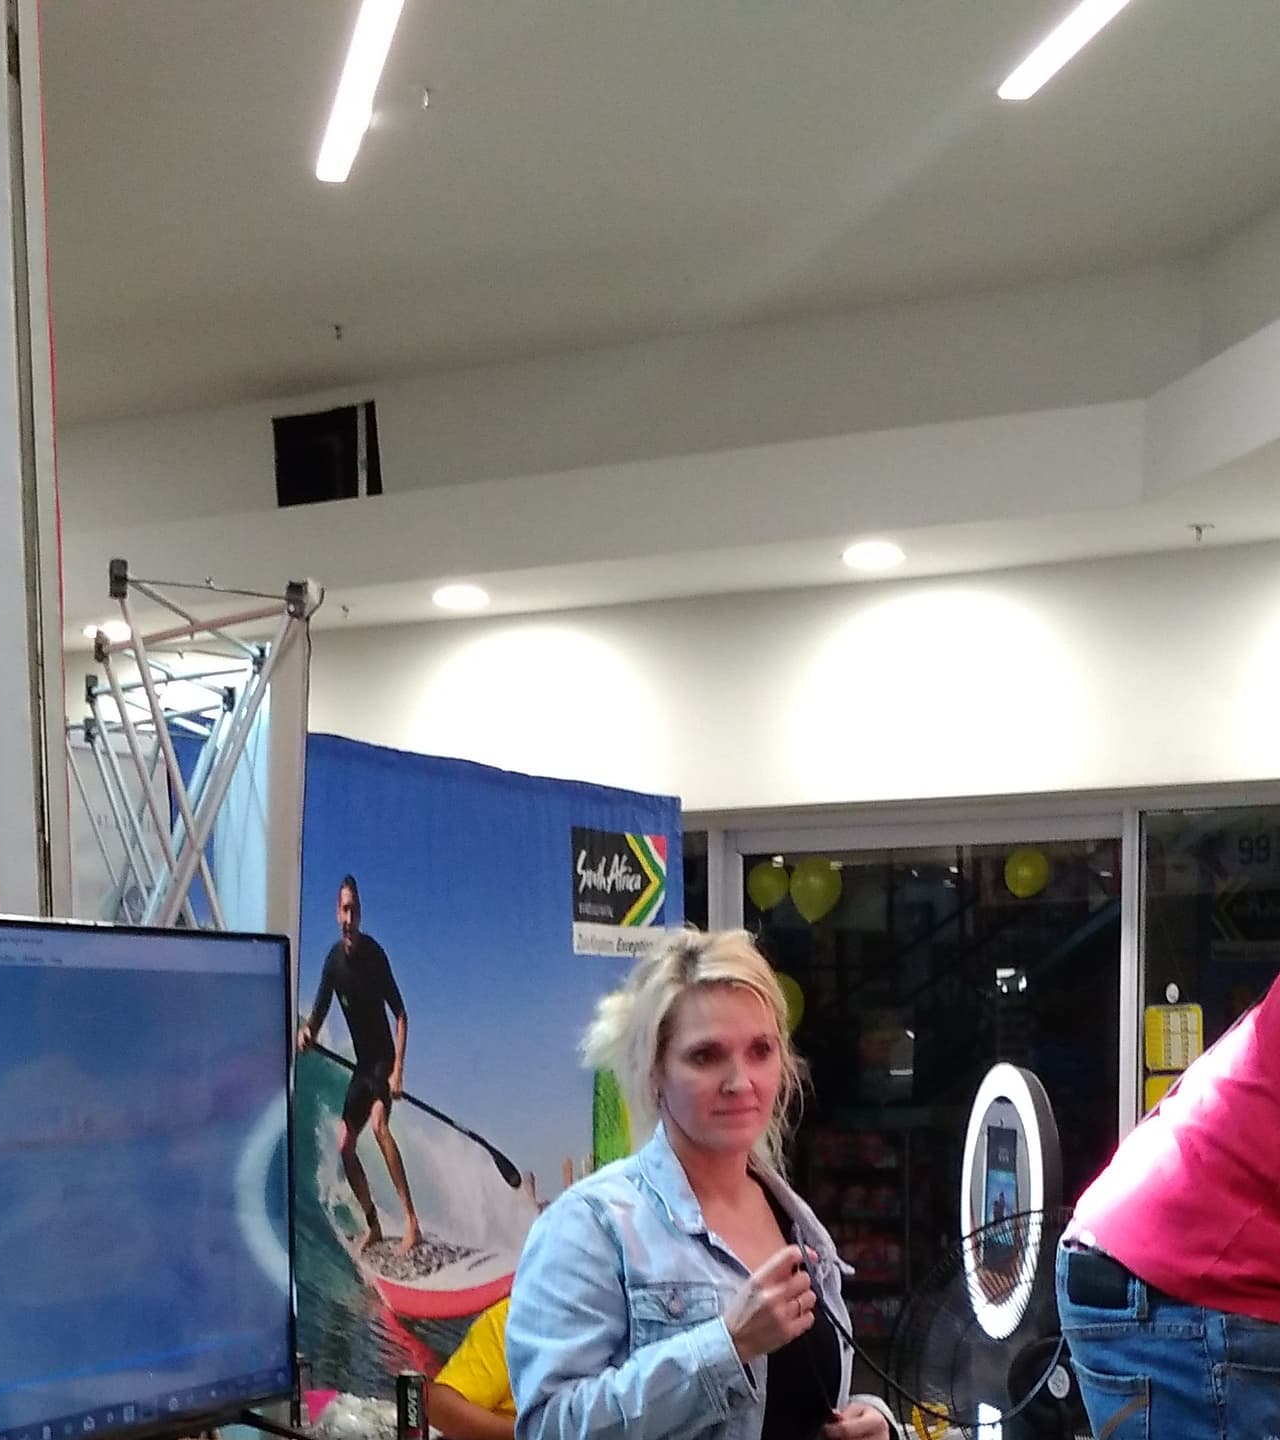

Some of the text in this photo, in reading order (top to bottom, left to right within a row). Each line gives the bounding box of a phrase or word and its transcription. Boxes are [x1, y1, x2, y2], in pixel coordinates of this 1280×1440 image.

[576, 849, 642, 895] South Africa
[407, 1387, 418, 1428] MOVE
